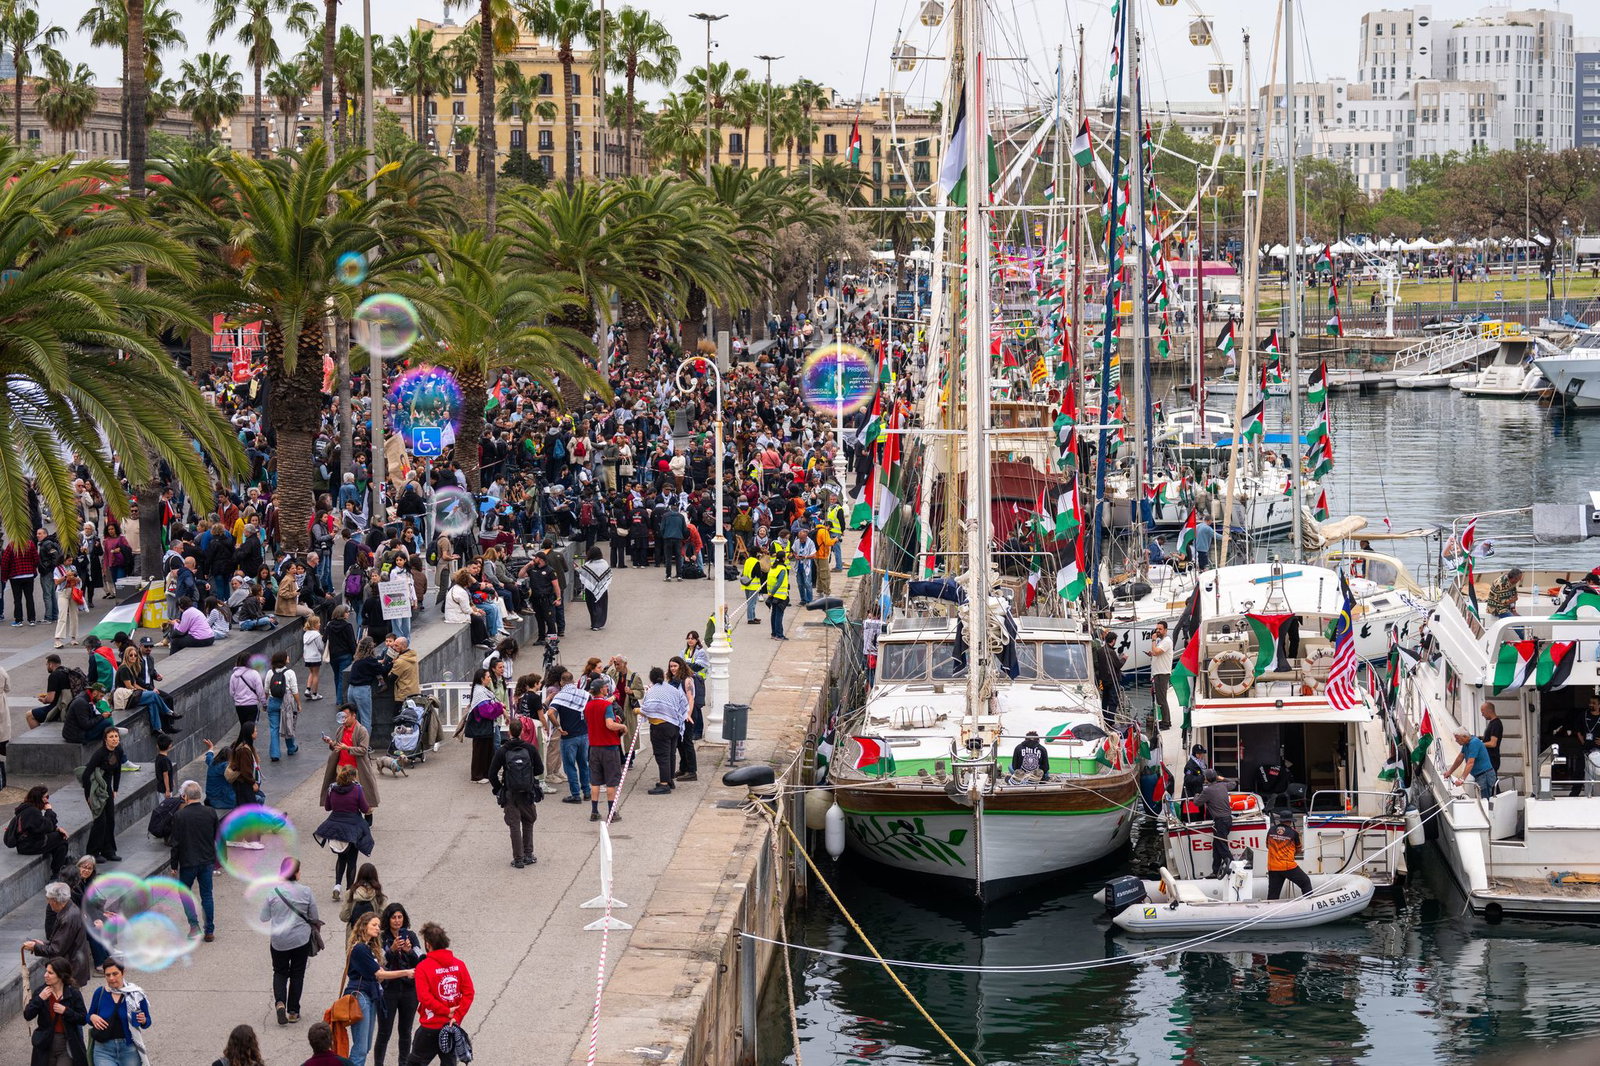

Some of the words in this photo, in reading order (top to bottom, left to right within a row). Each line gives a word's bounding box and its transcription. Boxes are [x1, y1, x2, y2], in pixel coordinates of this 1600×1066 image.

[1192, 837, 1245, 851] Esai
[1316, 900, 1329, 909] BA
[1329, 893, 1351, 906] 5-435
[1350, 889, 1361, 899] 04
